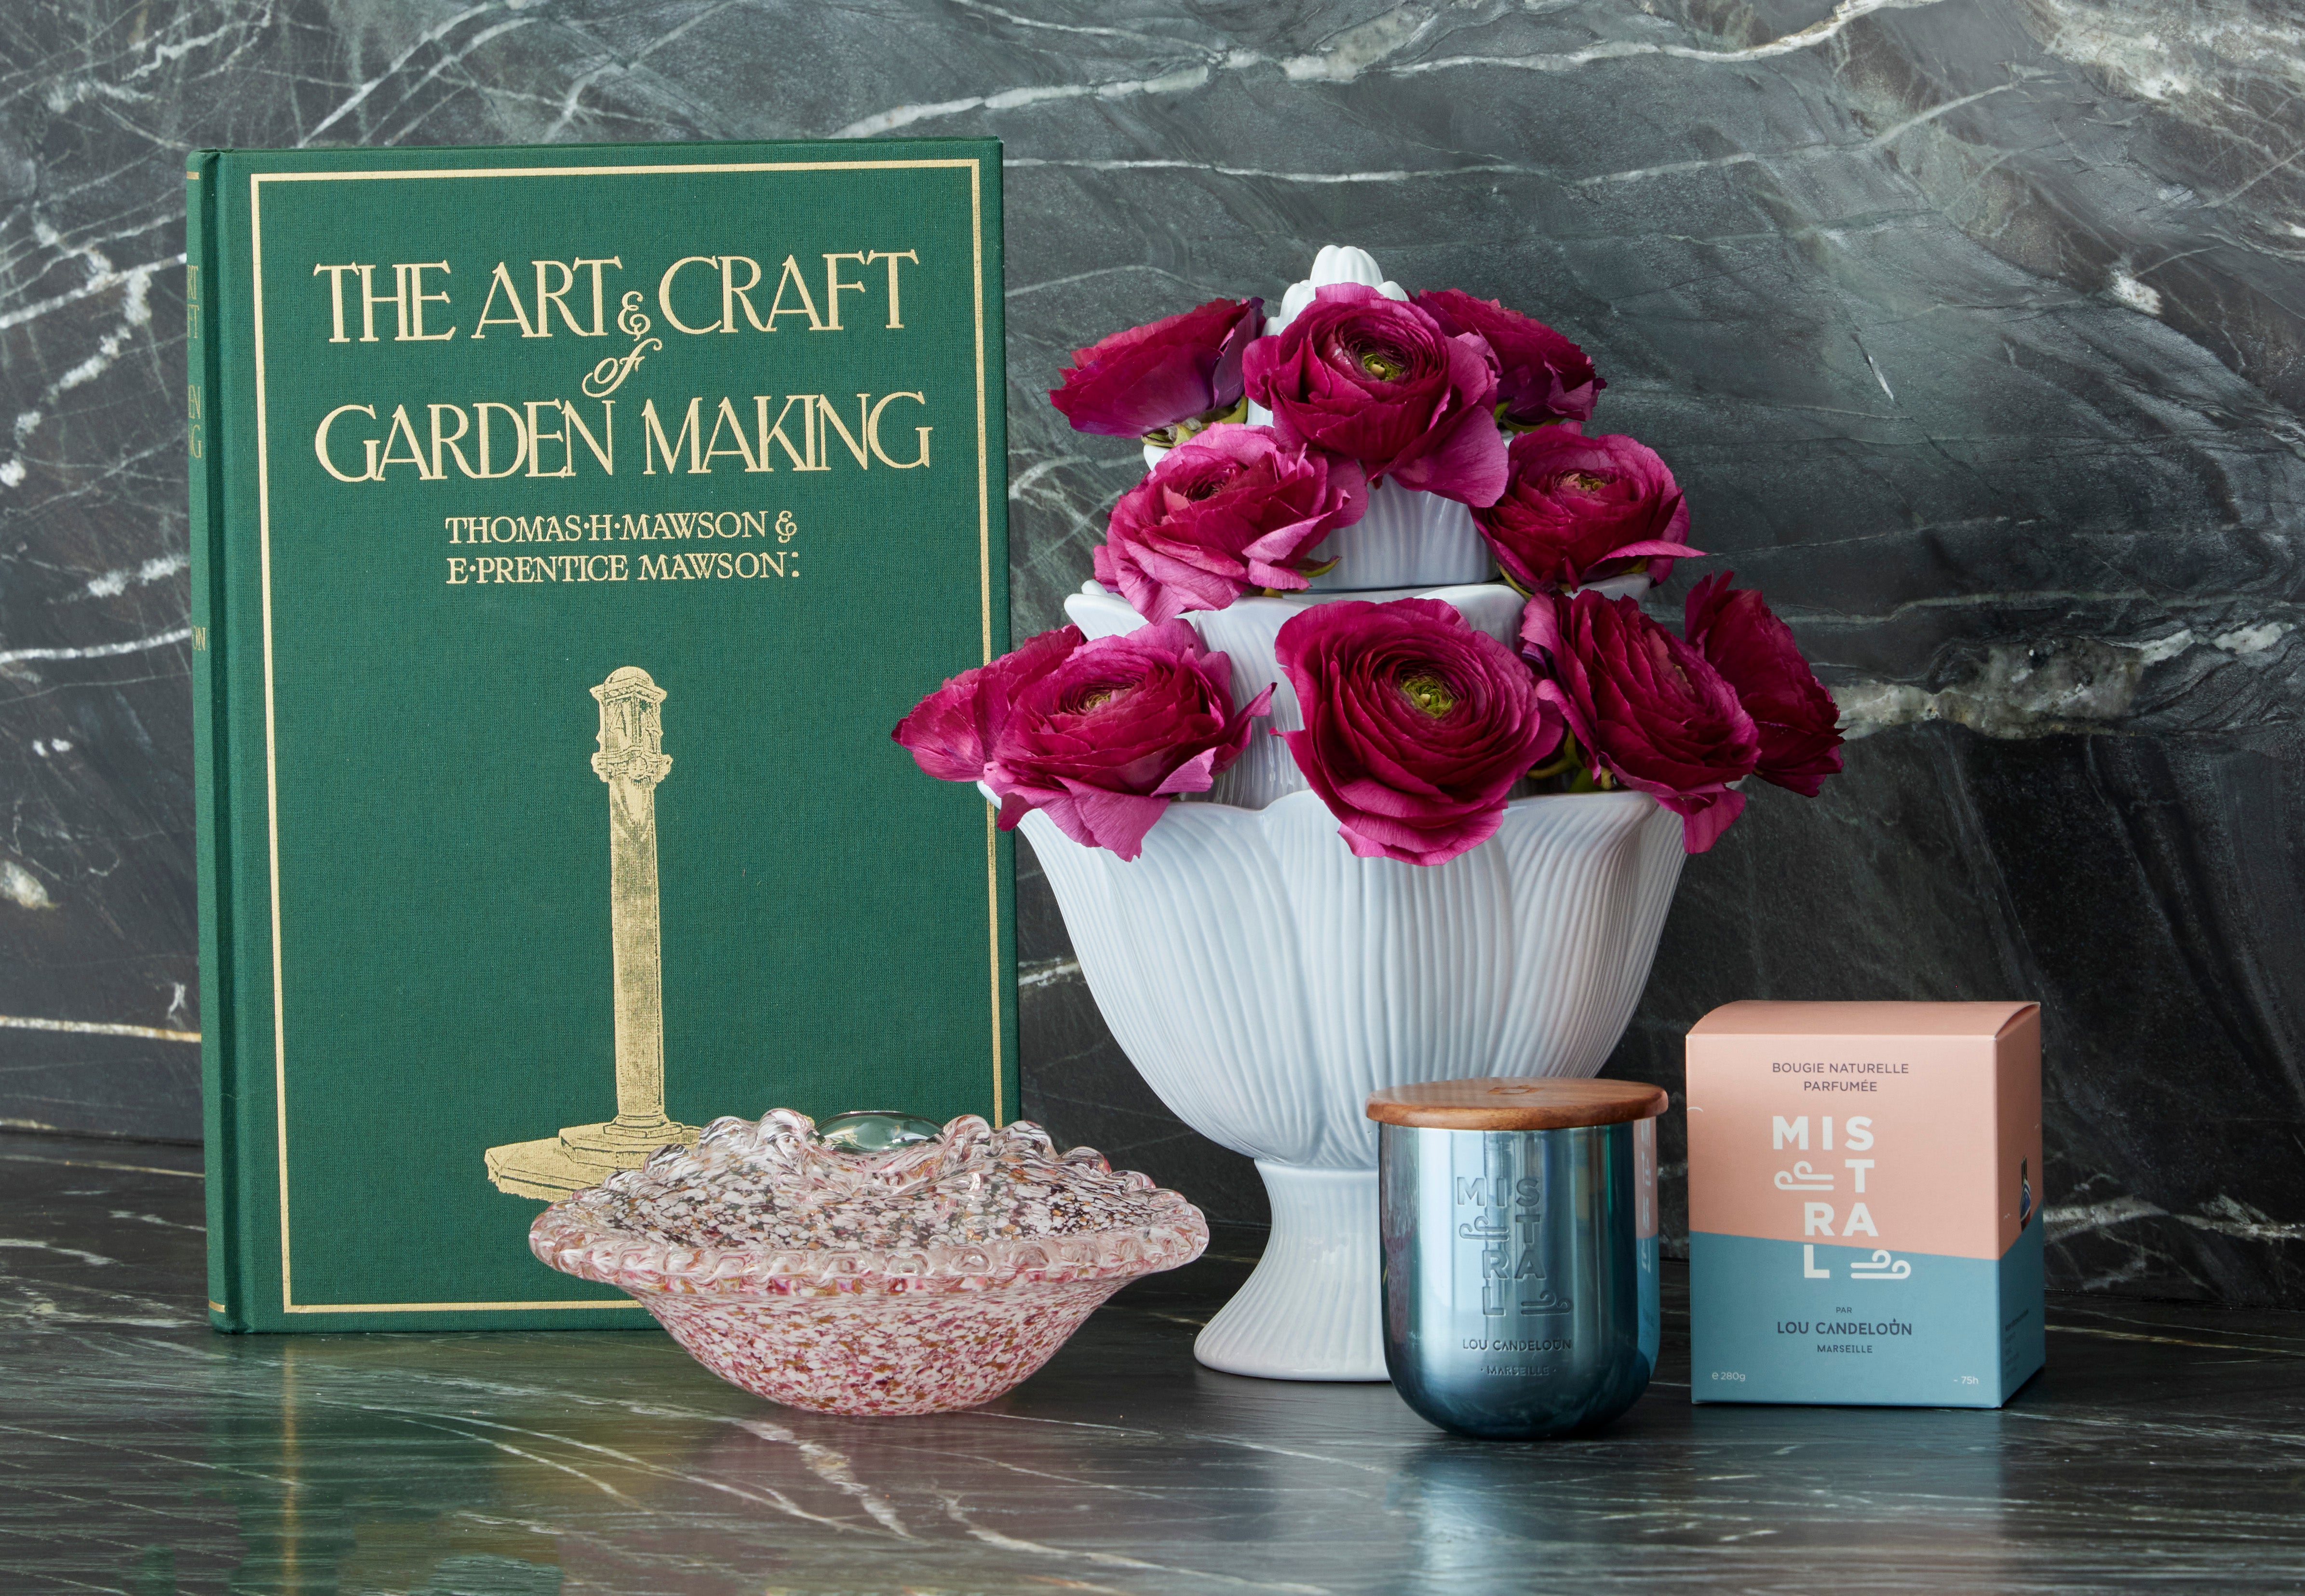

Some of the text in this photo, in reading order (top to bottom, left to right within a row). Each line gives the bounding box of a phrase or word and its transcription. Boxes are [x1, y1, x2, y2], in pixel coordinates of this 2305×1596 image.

[313, 249, 920, 343] THE ART & CRAFT
[580, 338, 662, 398] of
[314, 391, 933, 483] GARDEN MAKING
[775, 510, 797, 543] &
[1772, 1062, 1909, 1074] BOUGIE NATURELLE
[1804, 1079, 1877, 1092] PARFUMÉE
[1777, 1322, 1809, 1334] LOU
[1463, 1339, 1488, 1350] LOU
[1817, 1344, 1873, 1354] MARSEILLE
[1721, 1372, 1746, 1382] 280g
[1961, 1376, 1979, 1385] 75h
